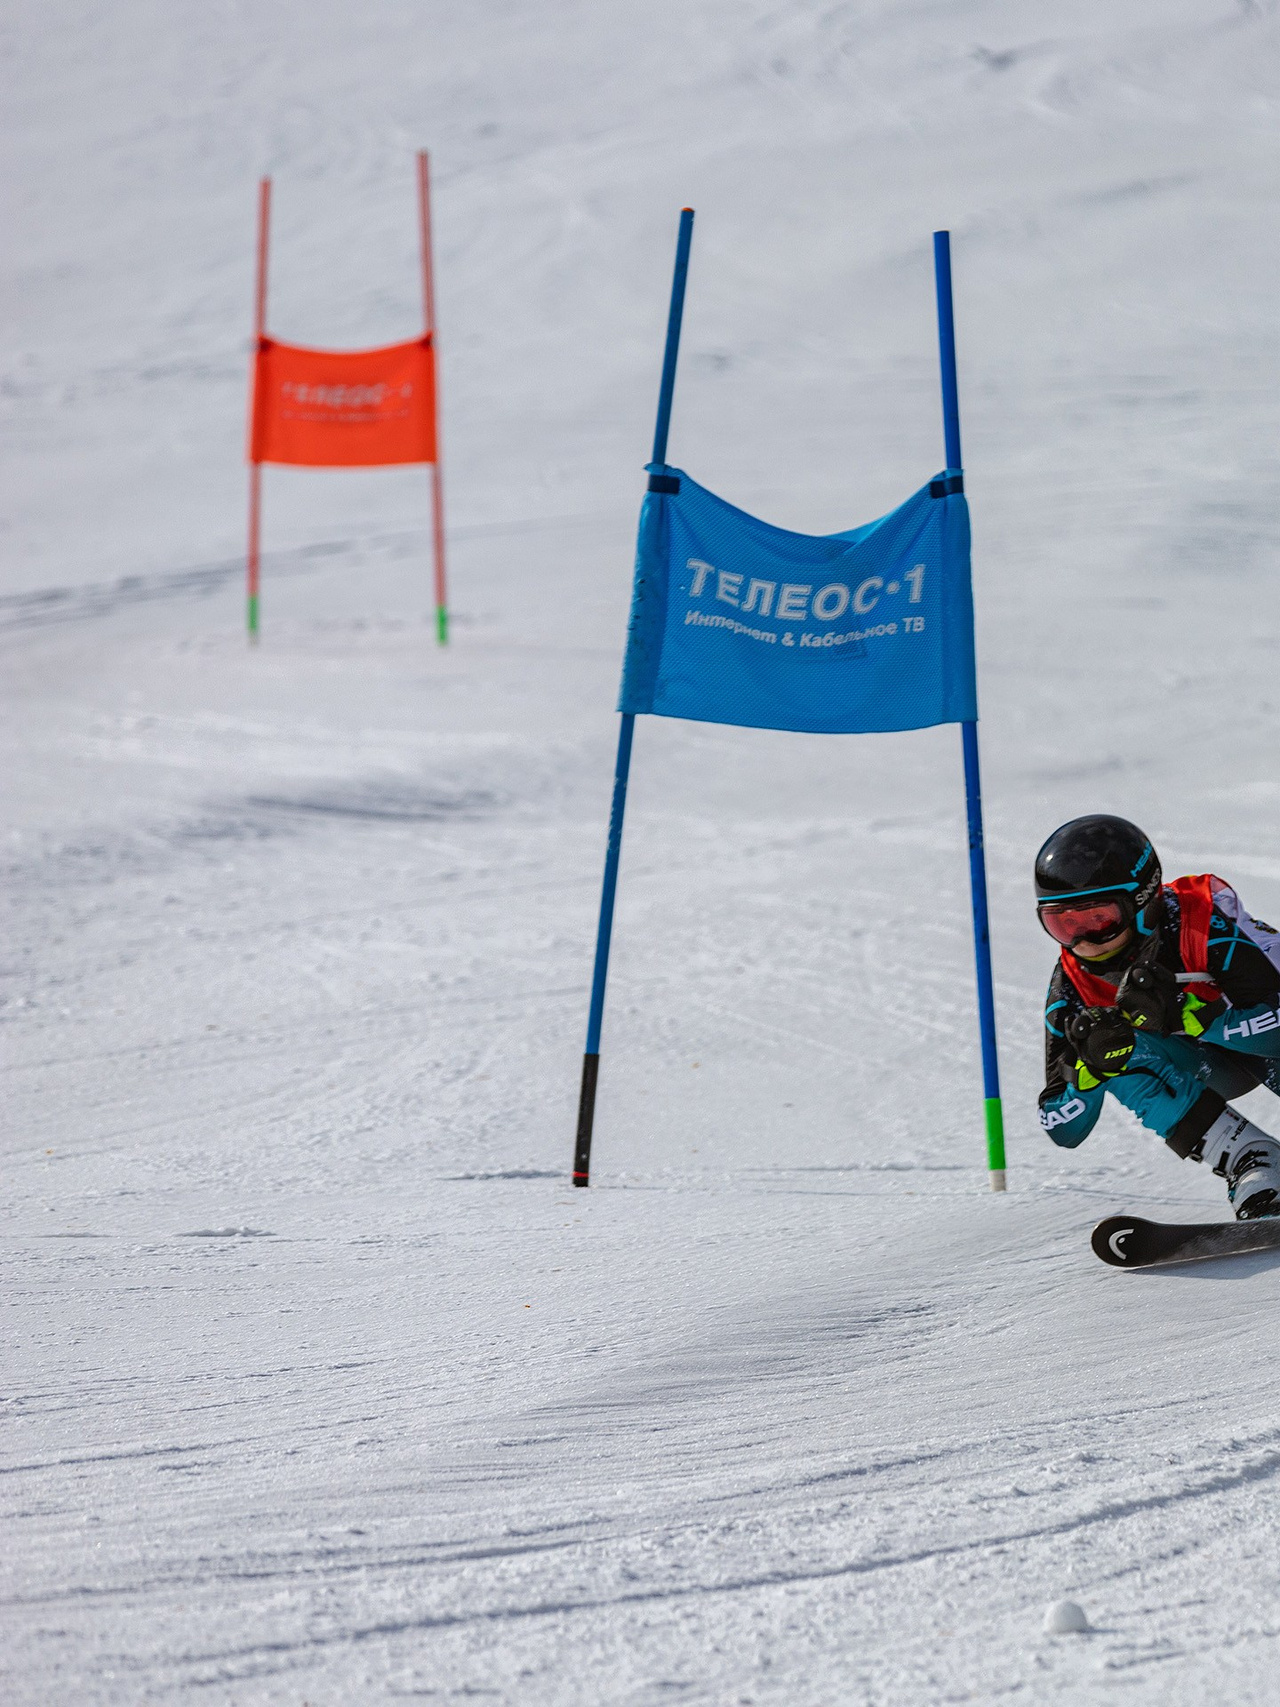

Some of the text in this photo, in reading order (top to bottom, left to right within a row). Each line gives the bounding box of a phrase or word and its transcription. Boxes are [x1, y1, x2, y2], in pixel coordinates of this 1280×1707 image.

[684, 610, 925, 647] Интернет & Кабельное ТВ
[1104, 1045, 1134, 1060] LEKI
[1038, 1098, 1087, 1131] EAD
